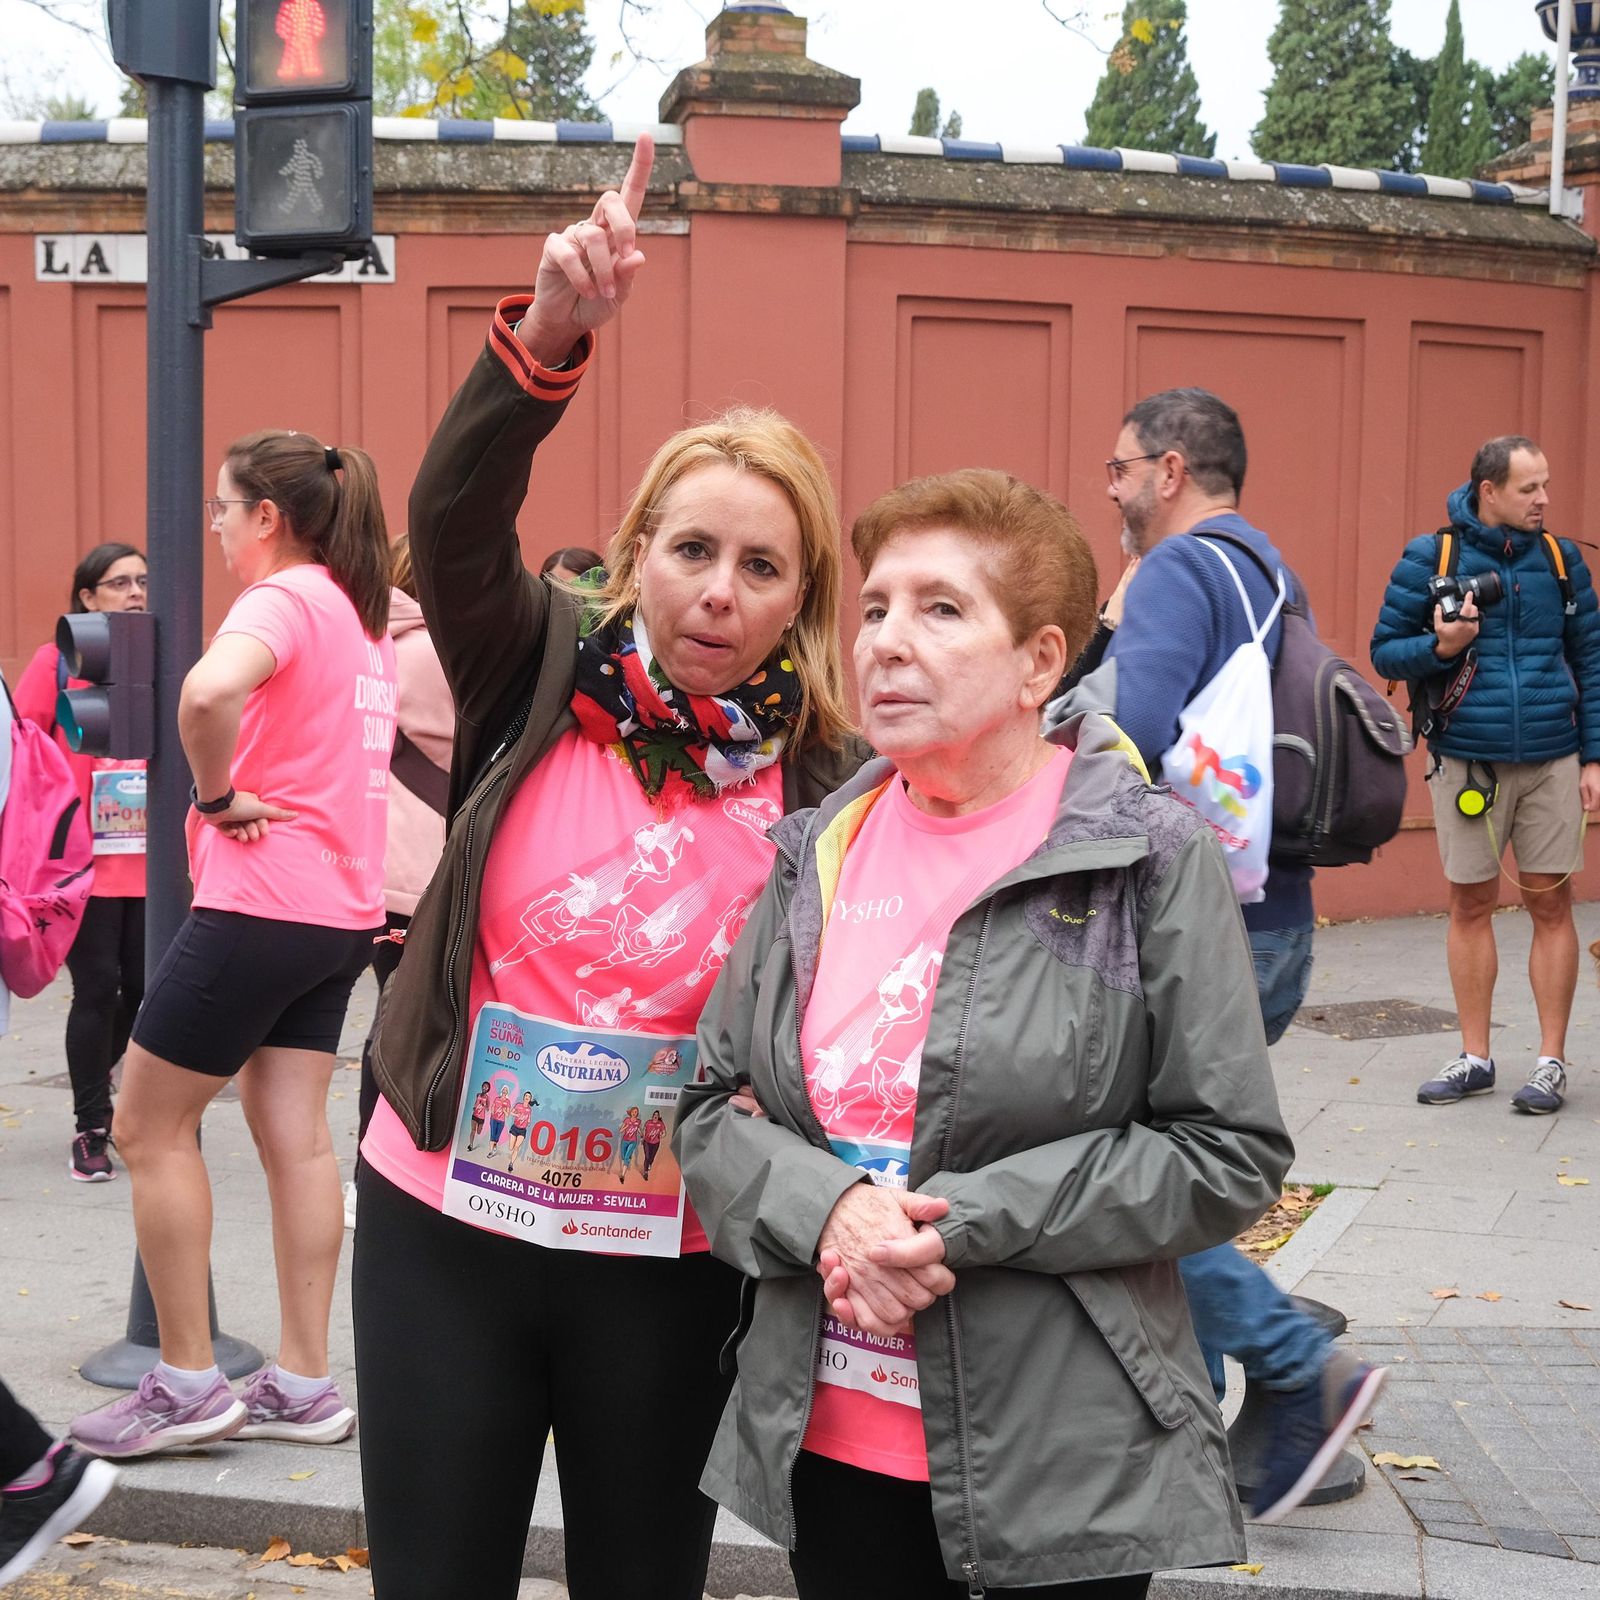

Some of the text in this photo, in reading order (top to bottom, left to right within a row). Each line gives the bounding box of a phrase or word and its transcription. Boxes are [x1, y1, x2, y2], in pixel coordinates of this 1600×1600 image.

[41, 239, 112, 275] LA
[362, 715, 393, 752] SUM
[121, 807, 147, 821] 01
[729, 802, 774, 830] ASTURI
[831, 895, 904, 924] YSHO
[491, 1018, 501, 1027] TU
[541, 1052, 622, 1081] ASTURIANA
[555, 1053, 587, 1066] CENTRAL
[529, 1119, 614, 1163] 016
[480, 1171, 647, 1208] CARRERA DE LA MUJER SEVILLA
[541, 1169, 582, 1188] 4076
[468, 1194, 652, 1240] OYSHO Santander
[837, 1323, 849, 1337] DE
[850, 1328, 863, 1342] LA
[866, 1332, 905, 1351] MUJER
[890, 1370, 919, 1390] San
